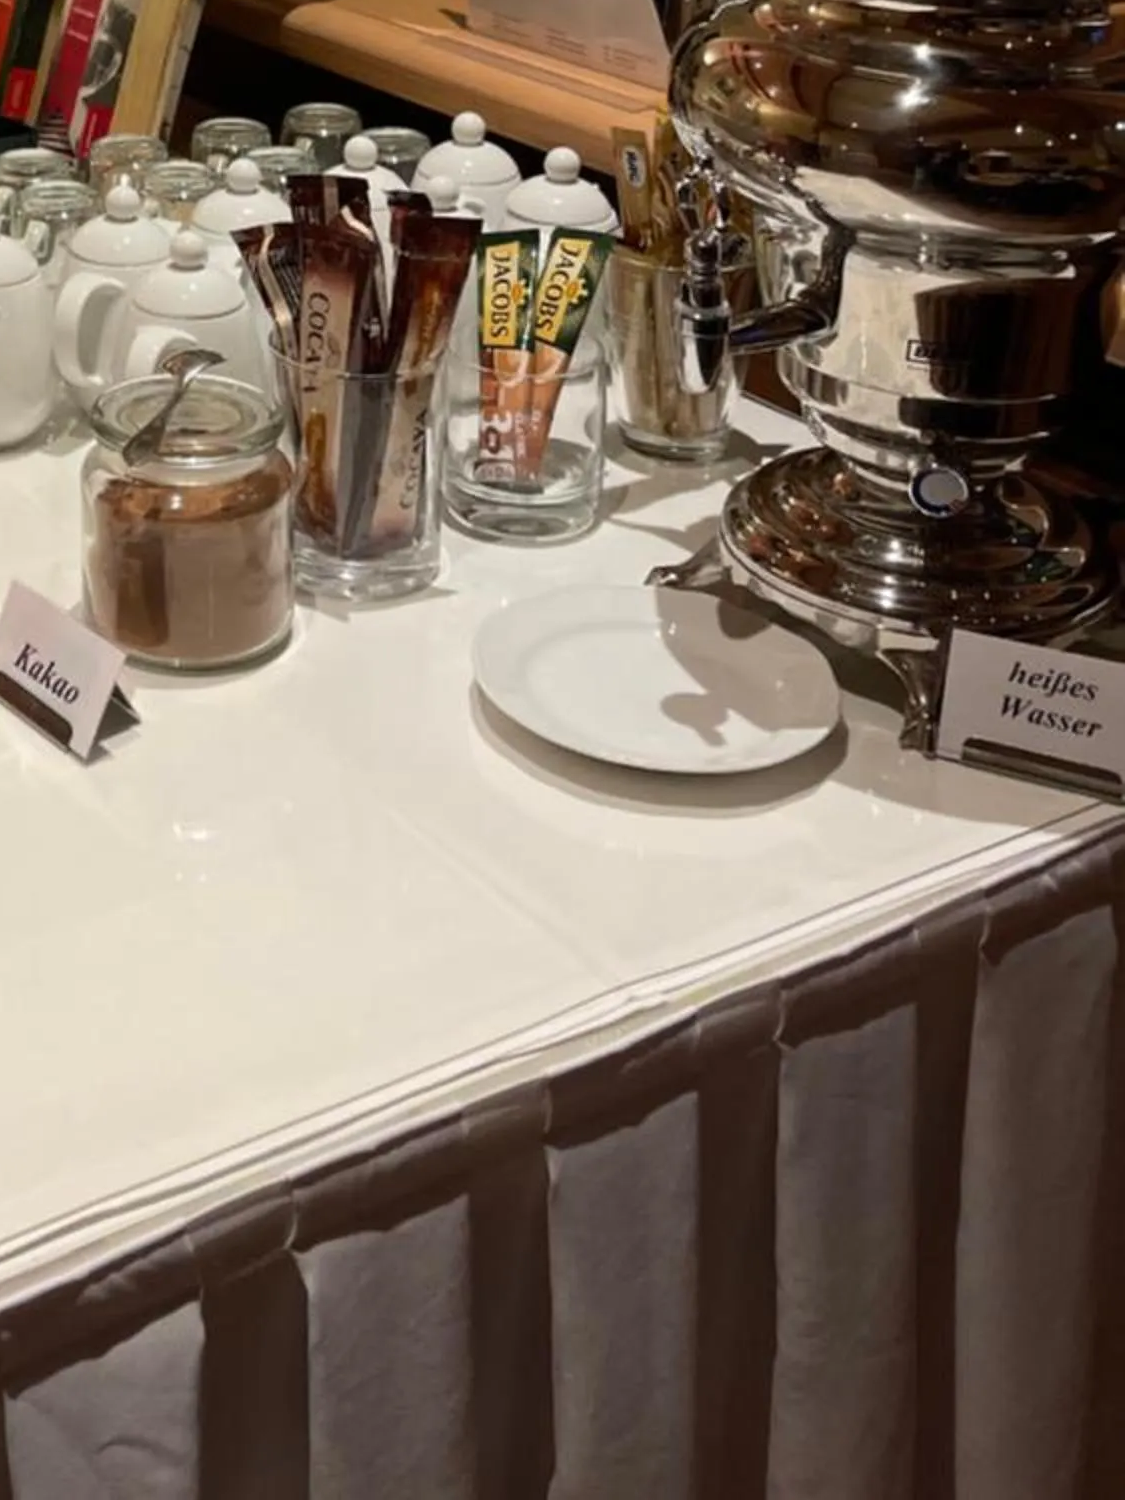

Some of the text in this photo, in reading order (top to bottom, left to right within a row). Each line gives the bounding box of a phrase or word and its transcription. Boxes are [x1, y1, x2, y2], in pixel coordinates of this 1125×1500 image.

[490, 250, 512, 339] JACOBS
[535, 239, 582, 333] JACOBS
[14, 643, 81, 705] Kakao
[1008, 661, 1100, 701] heißes
[1001, 694, 1104, 738] Wasser
